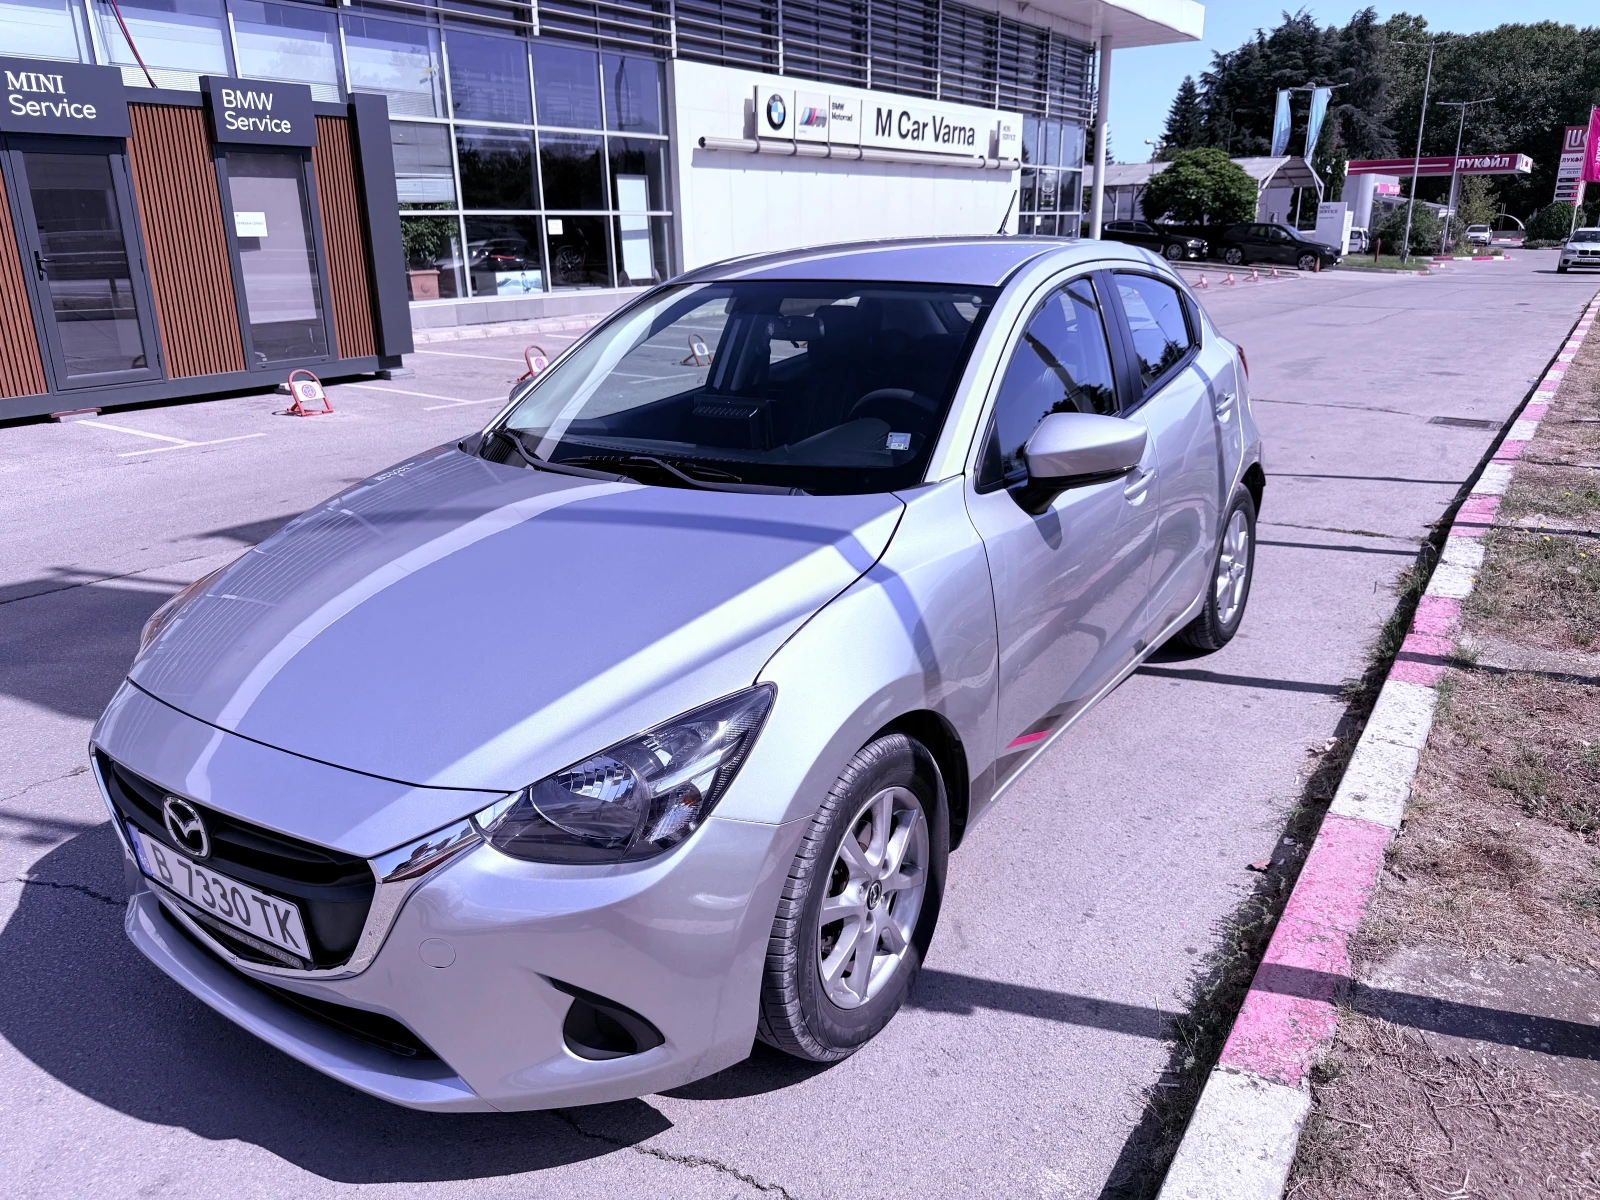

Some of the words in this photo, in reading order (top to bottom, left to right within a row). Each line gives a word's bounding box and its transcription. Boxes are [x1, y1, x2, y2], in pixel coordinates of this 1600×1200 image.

[4, 70, 66, 94] MINI
[8, 93, 97, 119] Service
[222, 88, 273, 111] BMW
[831, 102, 845, 111] BMW
[224, 110, 291, 134] Service
[831, 111, 853, 122] Motorrad
[875, 107, 892, 137] M
[897, 110, 928, 141] Car
[932, 115, 976, 146] Varna
[1456, 155, 1510, 168] ЛУКОЙЛ
[150, 842, 174, 885] B
[177, 858, 251, 927] 7330
[251, 894, 302, 950] TK
